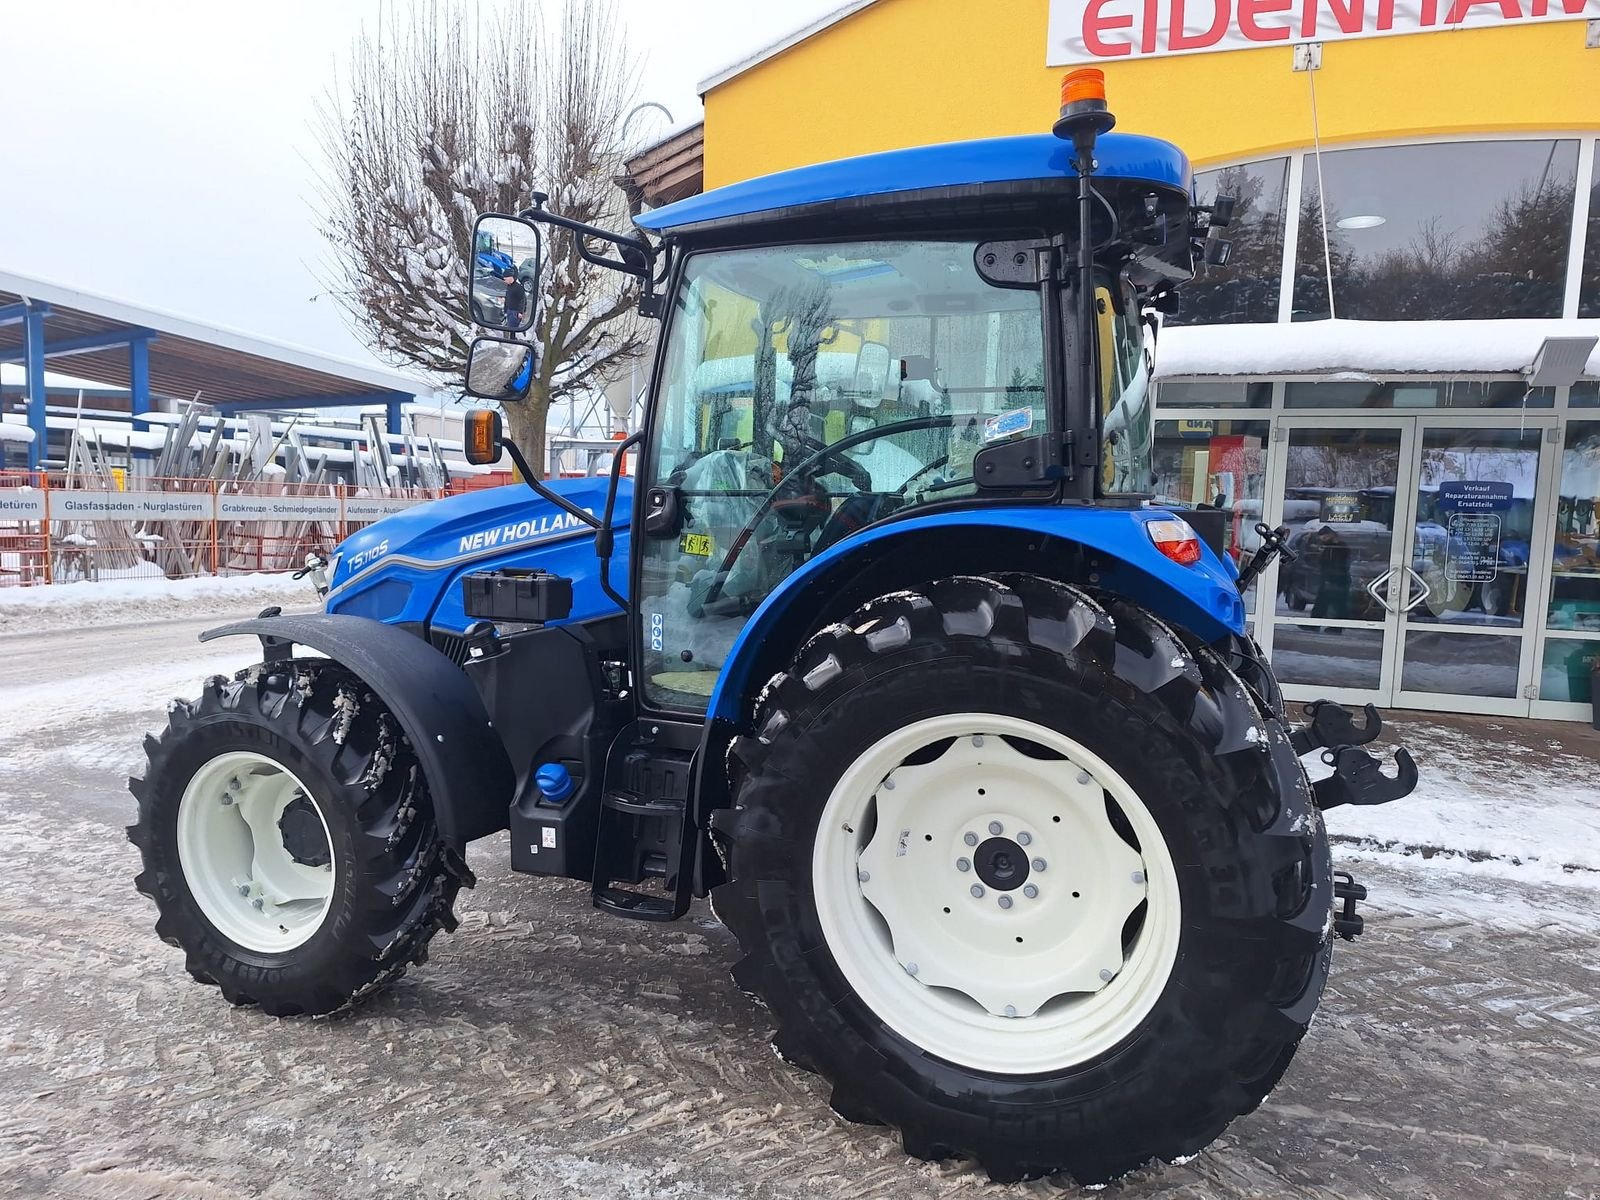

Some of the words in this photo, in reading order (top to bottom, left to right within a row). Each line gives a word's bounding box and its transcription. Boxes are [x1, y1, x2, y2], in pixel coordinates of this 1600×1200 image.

[1081, 0, 1588, 57] EIDEN
[1444, 492, 1508, 501] Reparaturannahme
[64, 500, 135, 511] Glasfassaden
[143, 502, 203, 513] Nurglastüren
[221, 503, 267, 513] Grabkreuze
[273, 504, 337, 515] Schmiedegeländer
[346, 506, 379, 514] Alufenster
[1457, 500, 1493, 508] Ersatzteile
[459, 526, 501, 553] NEW
